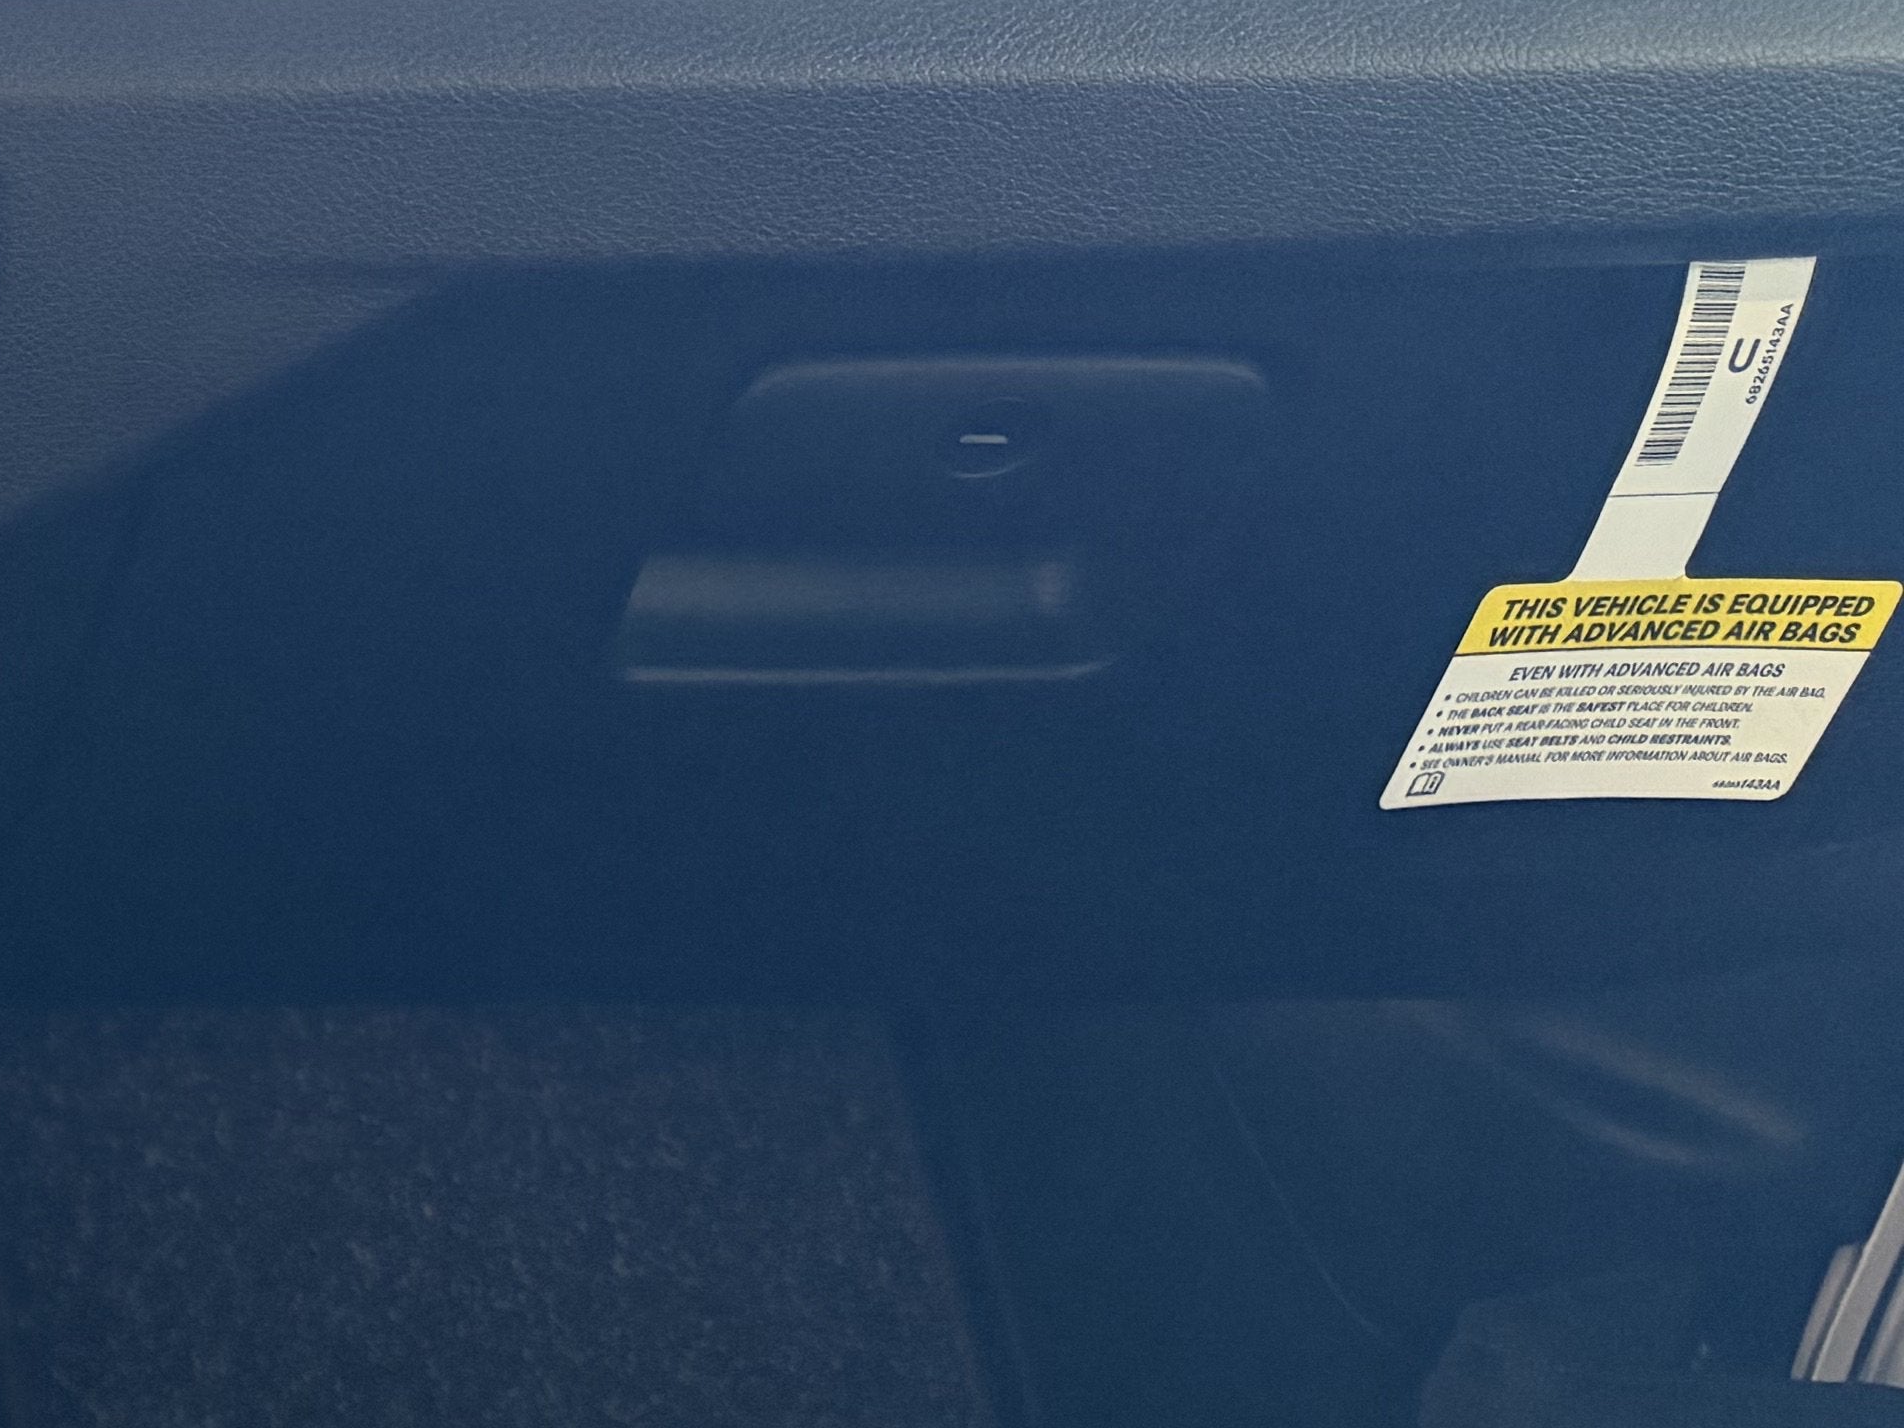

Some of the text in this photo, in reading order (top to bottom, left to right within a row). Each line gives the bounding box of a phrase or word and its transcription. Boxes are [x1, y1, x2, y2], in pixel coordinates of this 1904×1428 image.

[1728, 337, 1762, 373] U
[1745, 303, 1794, 404] 68265143AA
[1503, 593, 1876, 620] THIS VEHICLE IS EQUIPPED
[1489, 620, 1862, 647] WITH ADVANCED AIR BAGS
[1508, 662, 1786, 682] EVEN WITH ADVANCED AIR BAGS
[1456, 690, 1512, 703] CHILDREN
[1513, 689, 1539, 700] CAN
[1555, 686, 1596, 698] KILLED
[1597, 685, 1617, 696] OR
[1617, 684, 1682, 696] SERIOUSLY
[1682, 685, 1733, 696] INJURED
[1734, 685, 1750, 696] BY
[1752, 685, 1774, 697] THE
[1776, 686, 1797, 697] AIR
[1447, 708, 1470, 720] THE
[1470, 706, 1506, 719] BACK
[1506, 704, 1537, 717] SEAT
[1552, 702, 1576, 713] THE
[1576, 700, 1626, 712] SAFEST
[1626, 700, 1665, 712] PLACE
[1665, 700, 1691, 712] FOR
[1438, 724, 1481, 737] NEVER
[1481, 722, 1504, 734] PUT
[1590, 718, 1627, 729] CHILD
[1628, 717, 1658, 729] SEAT
[1658, 717, 1674, 728] IN
[1674, 717, 1698, 729] THE
[1428, 739, 1481, 753] ALWAYS
[1505, 736, 1539, 748] SEAT
[1539, 735, 1579, 747] BELTS
[1579, 734, 1606, 745] AND
[1606, 734, 1648, 745] CHILD
[1420, 758, 1442, 770] SEE
[1495, 753, 1542, 765] MANUAL
[1543, 751, 1570, 763] FOR
[1570, 750, 1606, 762] MORE
[1606, 750, 1688, 762] INFORMATION
[1688, 750, 1731, 762] ABOUT
[1730, 752, 1753, 763] AIR
